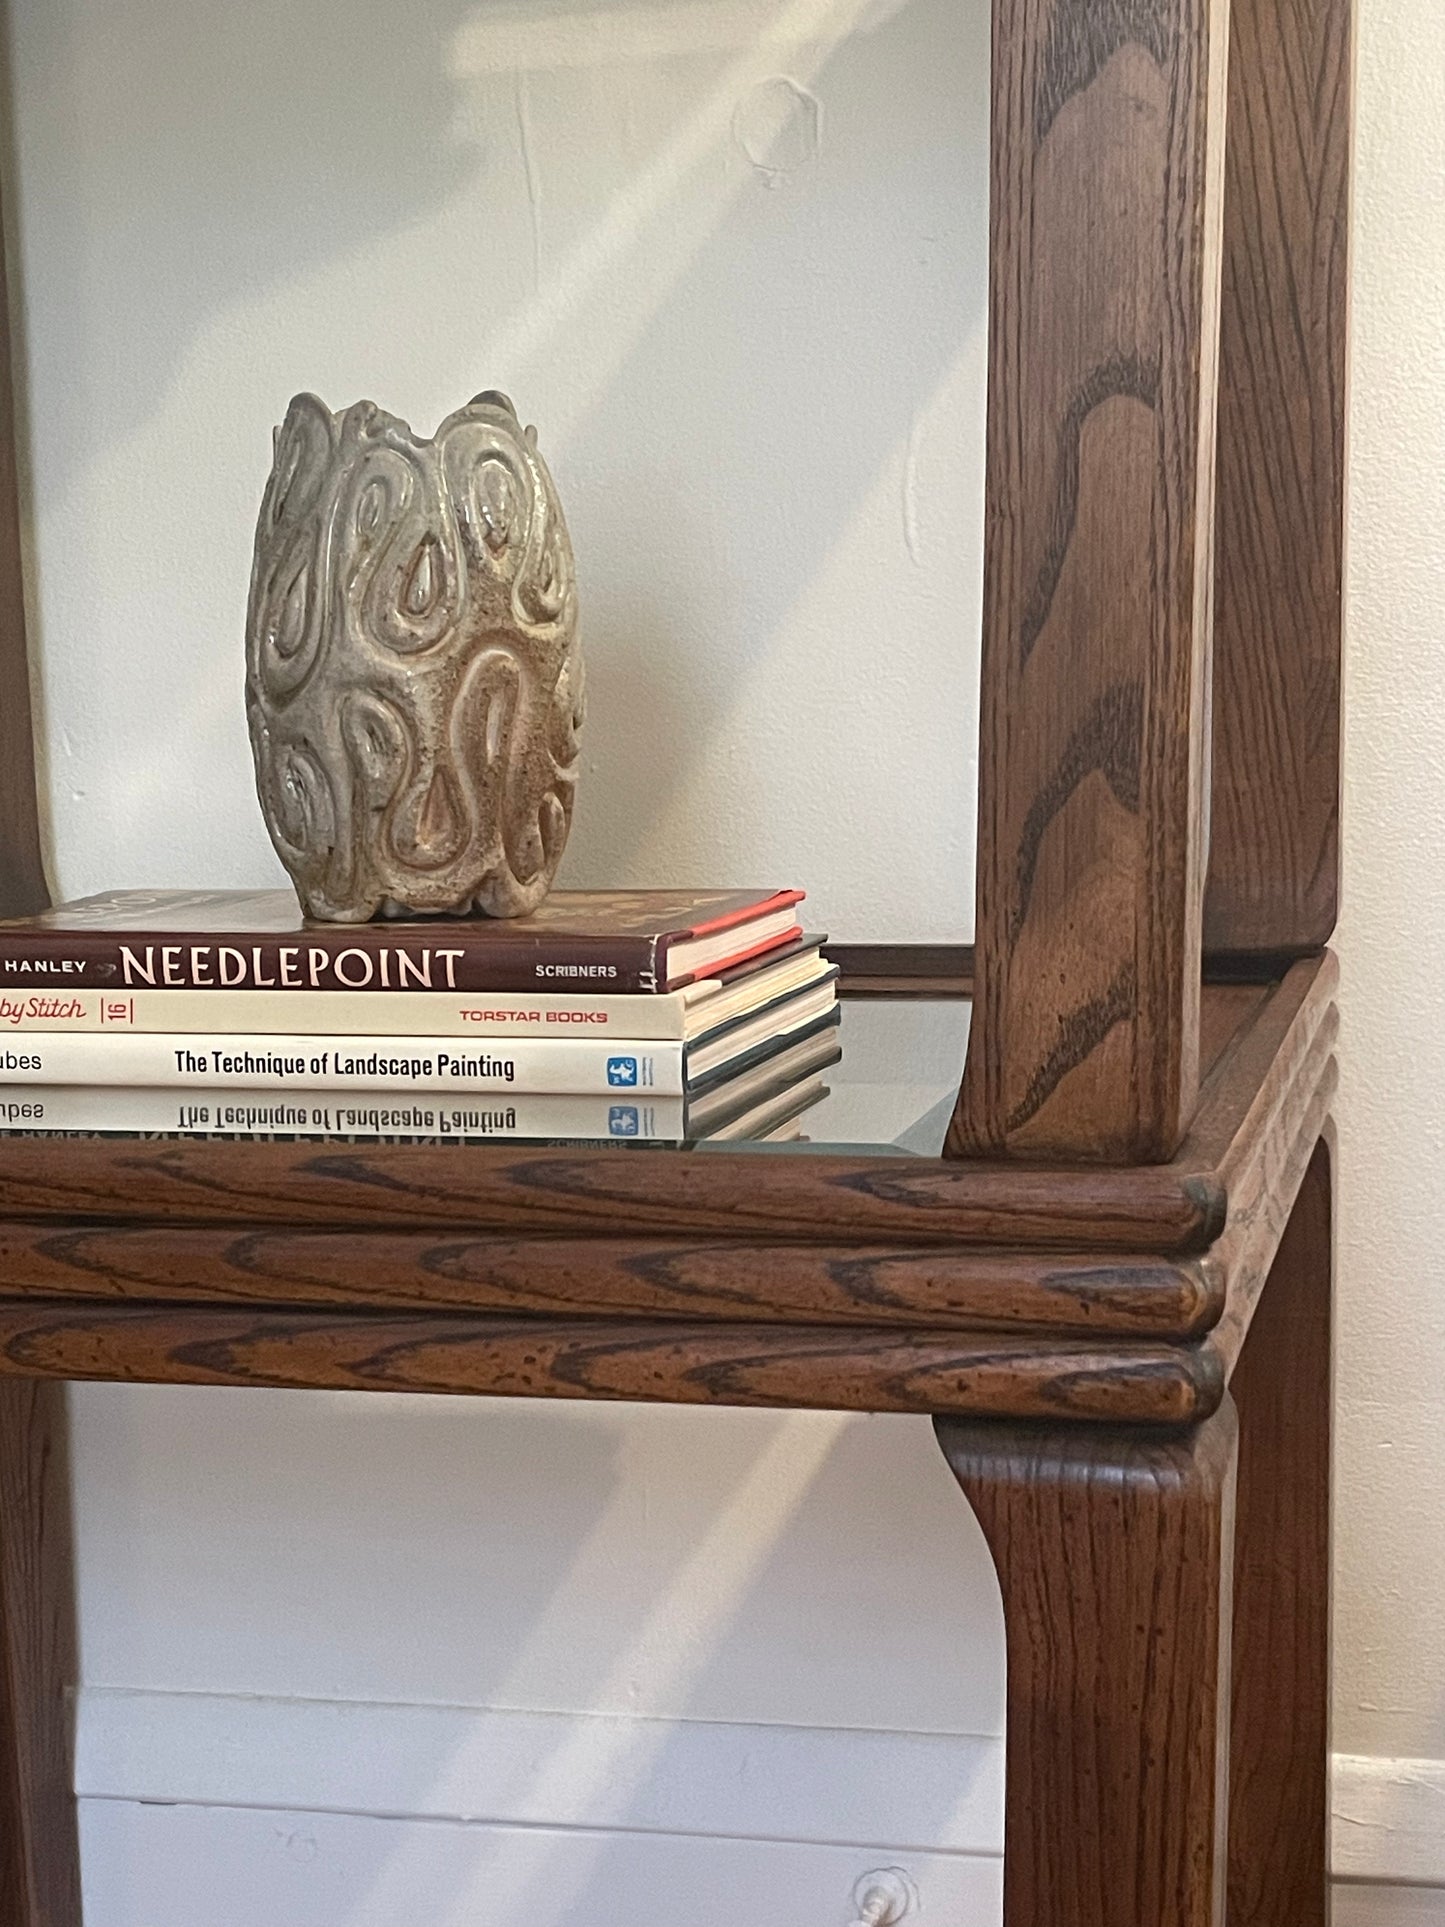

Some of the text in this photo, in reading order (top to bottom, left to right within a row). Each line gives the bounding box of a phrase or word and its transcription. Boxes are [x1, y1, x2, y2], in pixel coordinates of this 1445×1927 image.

[4, 960, 87, 973] HANLEY
[119, 946, 465, 989] NEEDLEPOINT
[535, 964, 618, 978] SCRIBNERS
[107, 1004, 127, 1020] 16
[459, 1010, 608, 1023] TORSTAR BOOKS
[175, 1050, 515, 1082] The Technique of Landscape Painting
